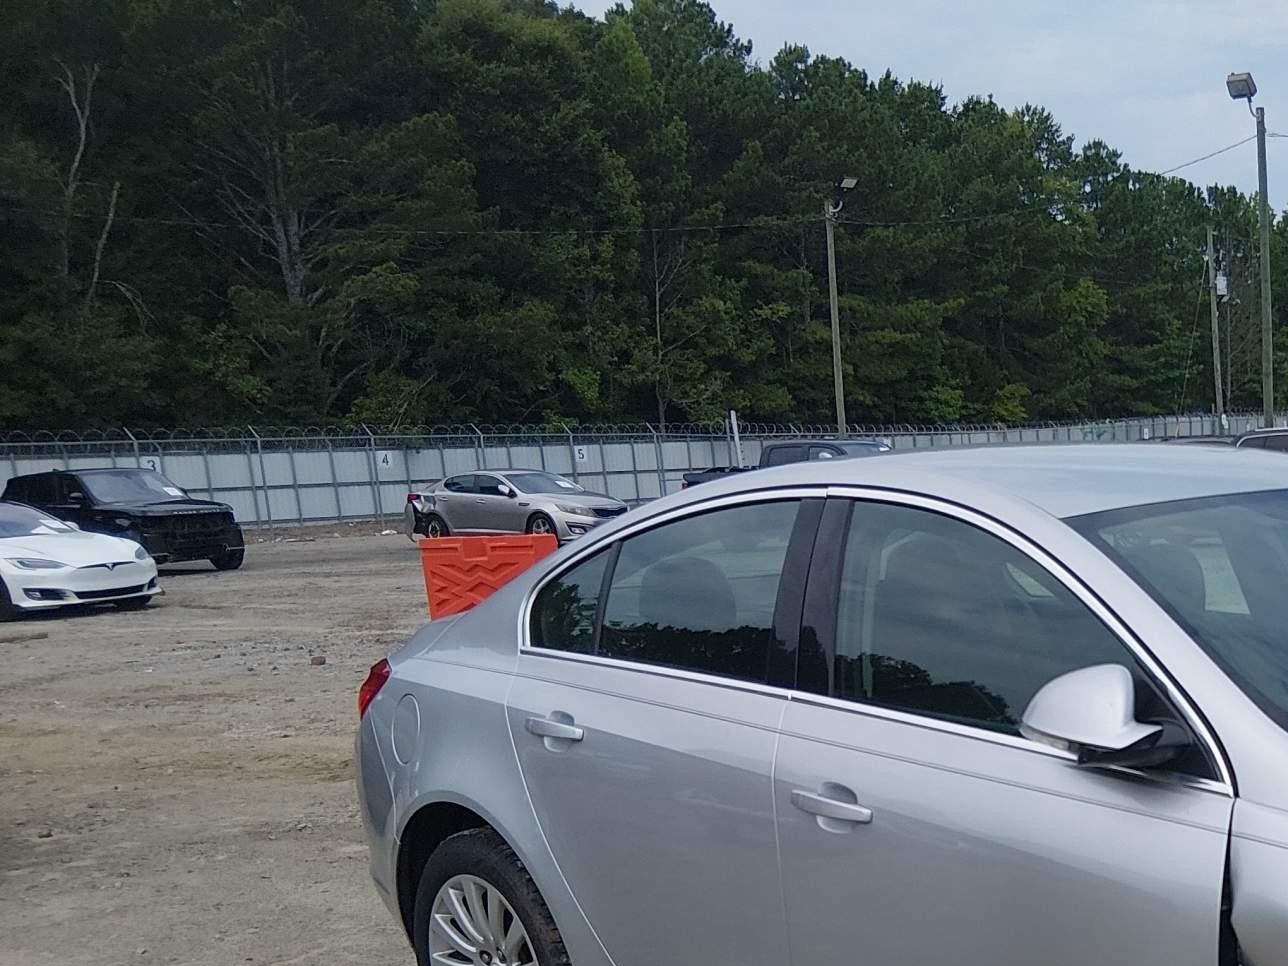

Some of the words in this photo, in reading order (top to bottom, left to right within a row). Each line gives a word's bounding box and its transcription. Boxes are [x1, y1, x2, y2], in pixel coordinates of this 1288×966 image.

[382, 454, 389, 466] 4
[578, 448, 585, 460] 5
[147, 459, 156, 472] 3
